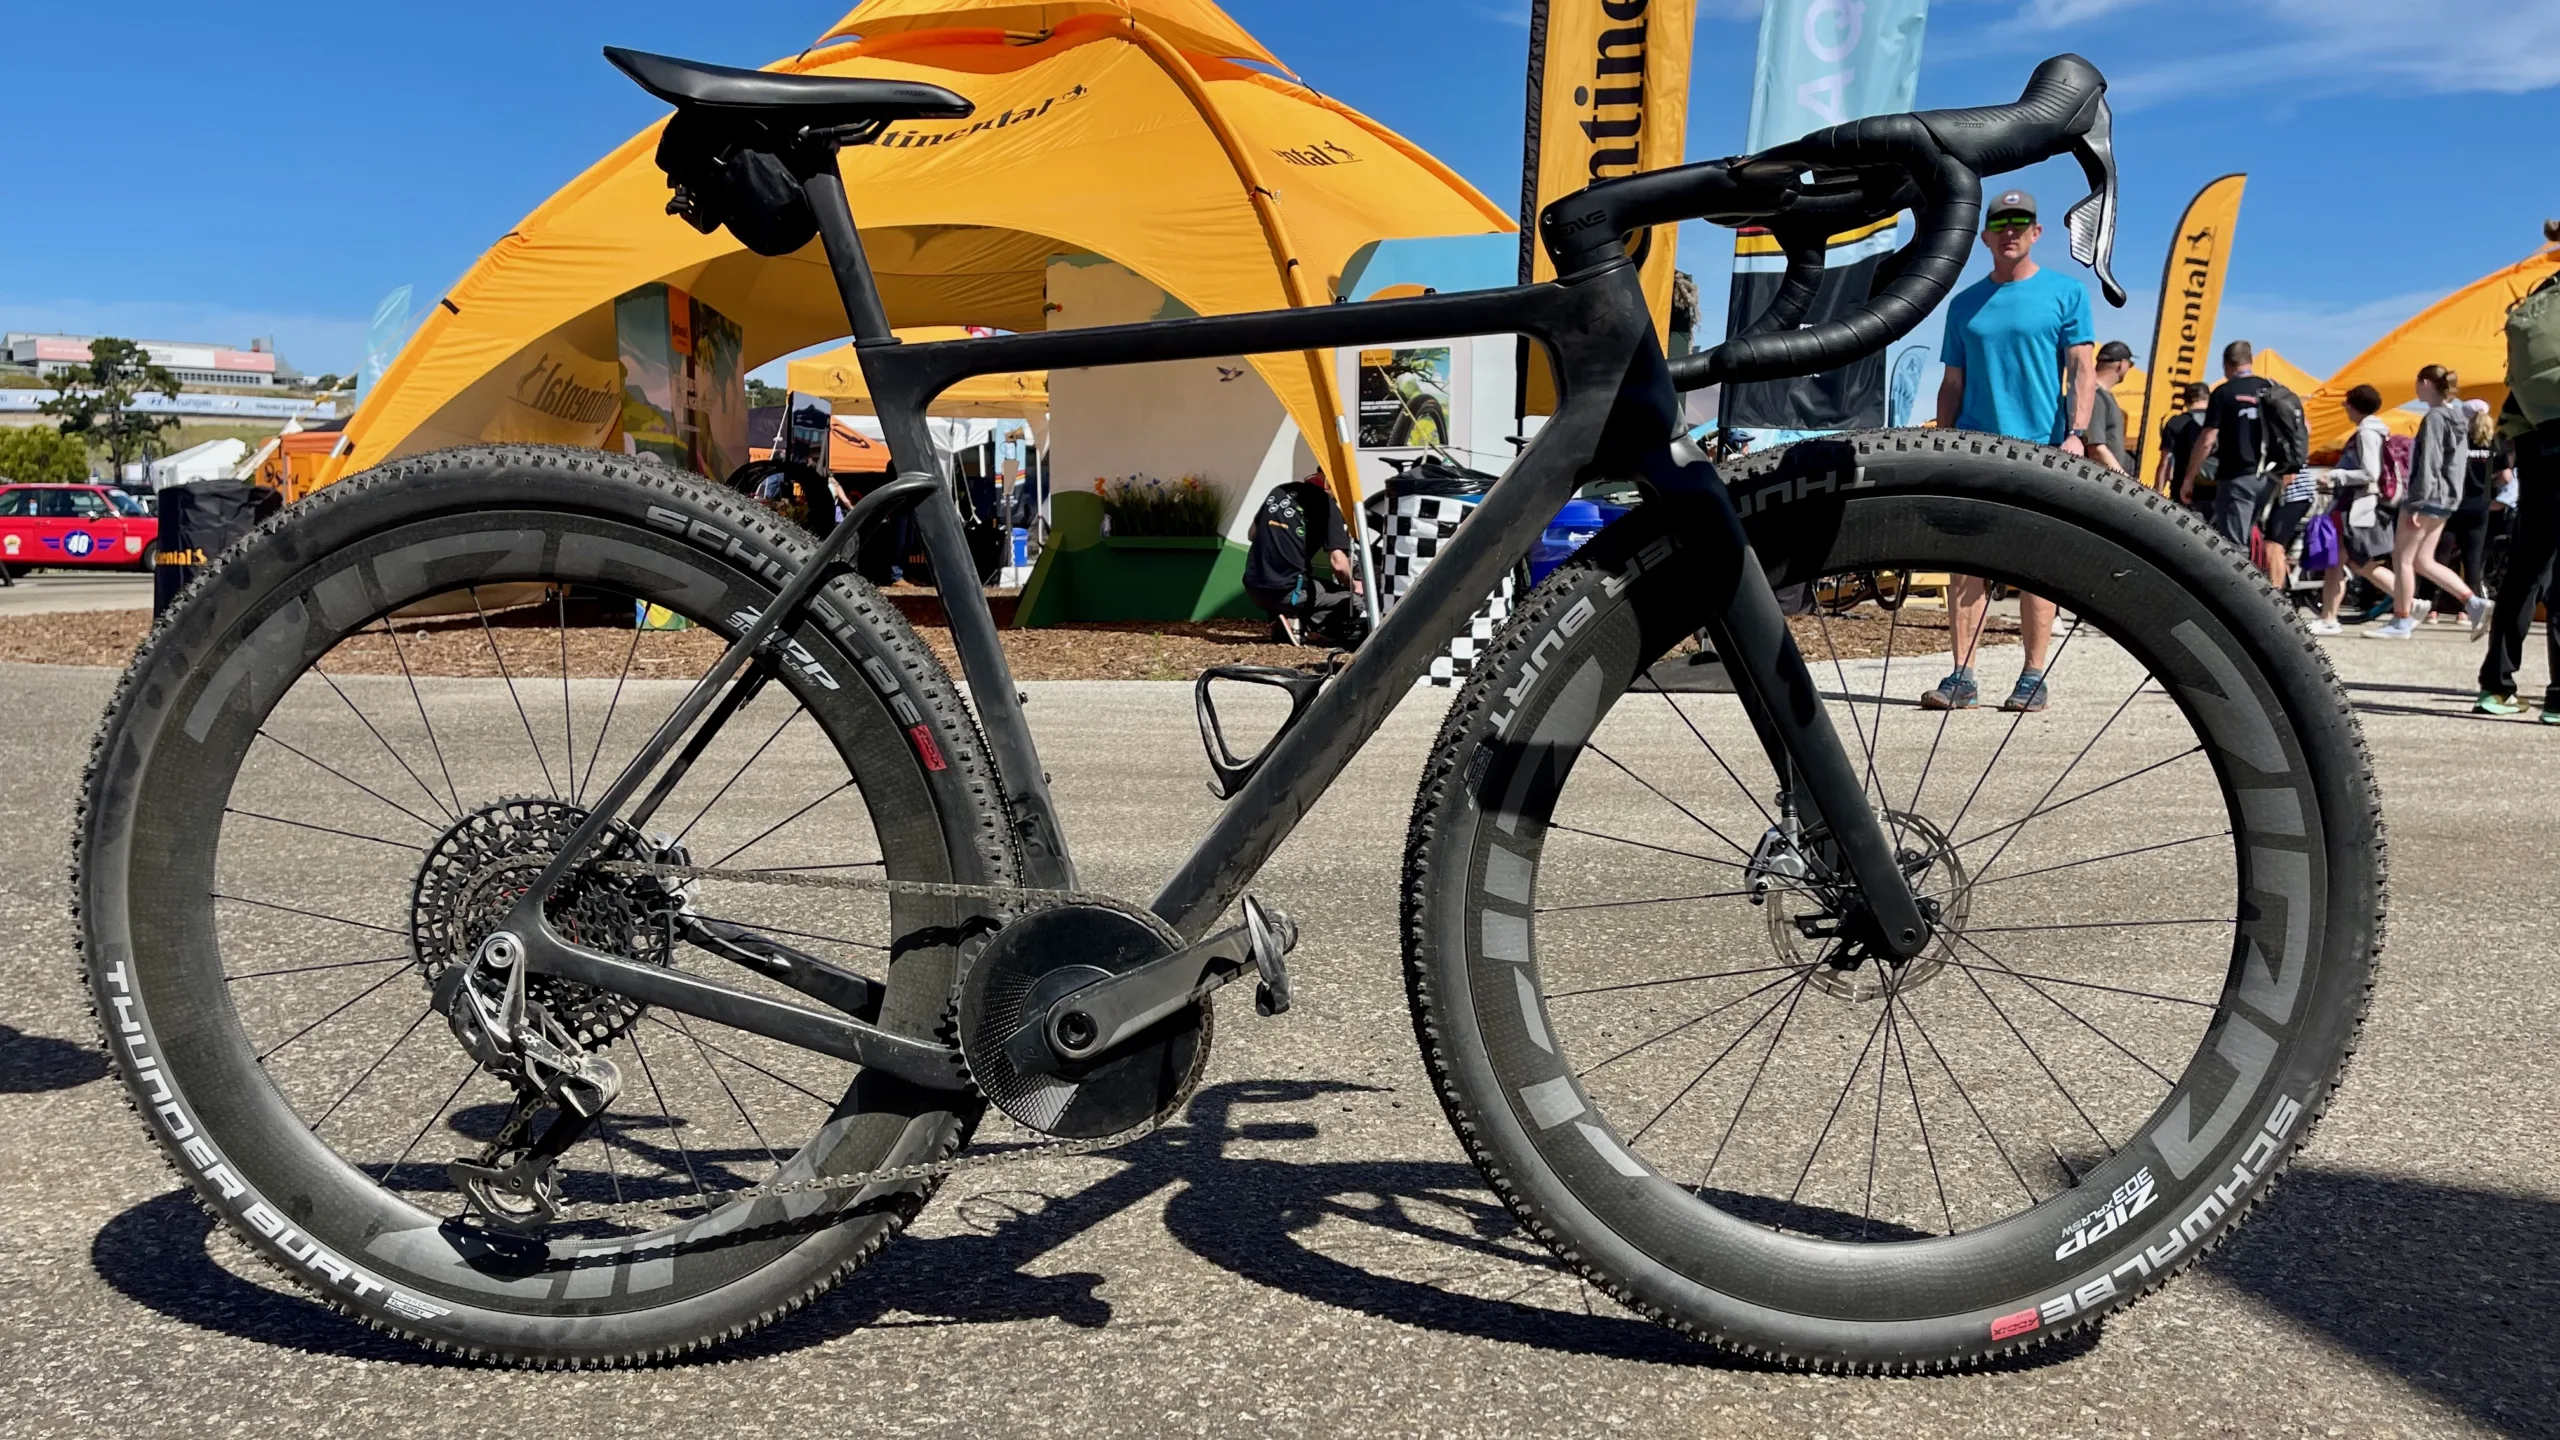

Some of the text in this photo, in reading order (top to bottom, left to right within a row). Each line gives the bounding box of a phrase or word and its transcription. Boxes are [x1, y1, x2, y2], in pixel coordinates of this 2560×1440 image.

[868, 97, 1055, 148] tinental
[2163, 257, 2209, 418] ntinental
[67, 534, 89, 554] 40
[908, 552, 928, 564] nti
[1488, 595, 1597, 740] BURT
[107, 960, 385, 1297] THUNDER BURT
[2040, 1093, 2302, 1325] SCHWALBE
[2055, 1179, 2159, 1262] ZIPP
[2112, 1166, 2153, 1201] 303
